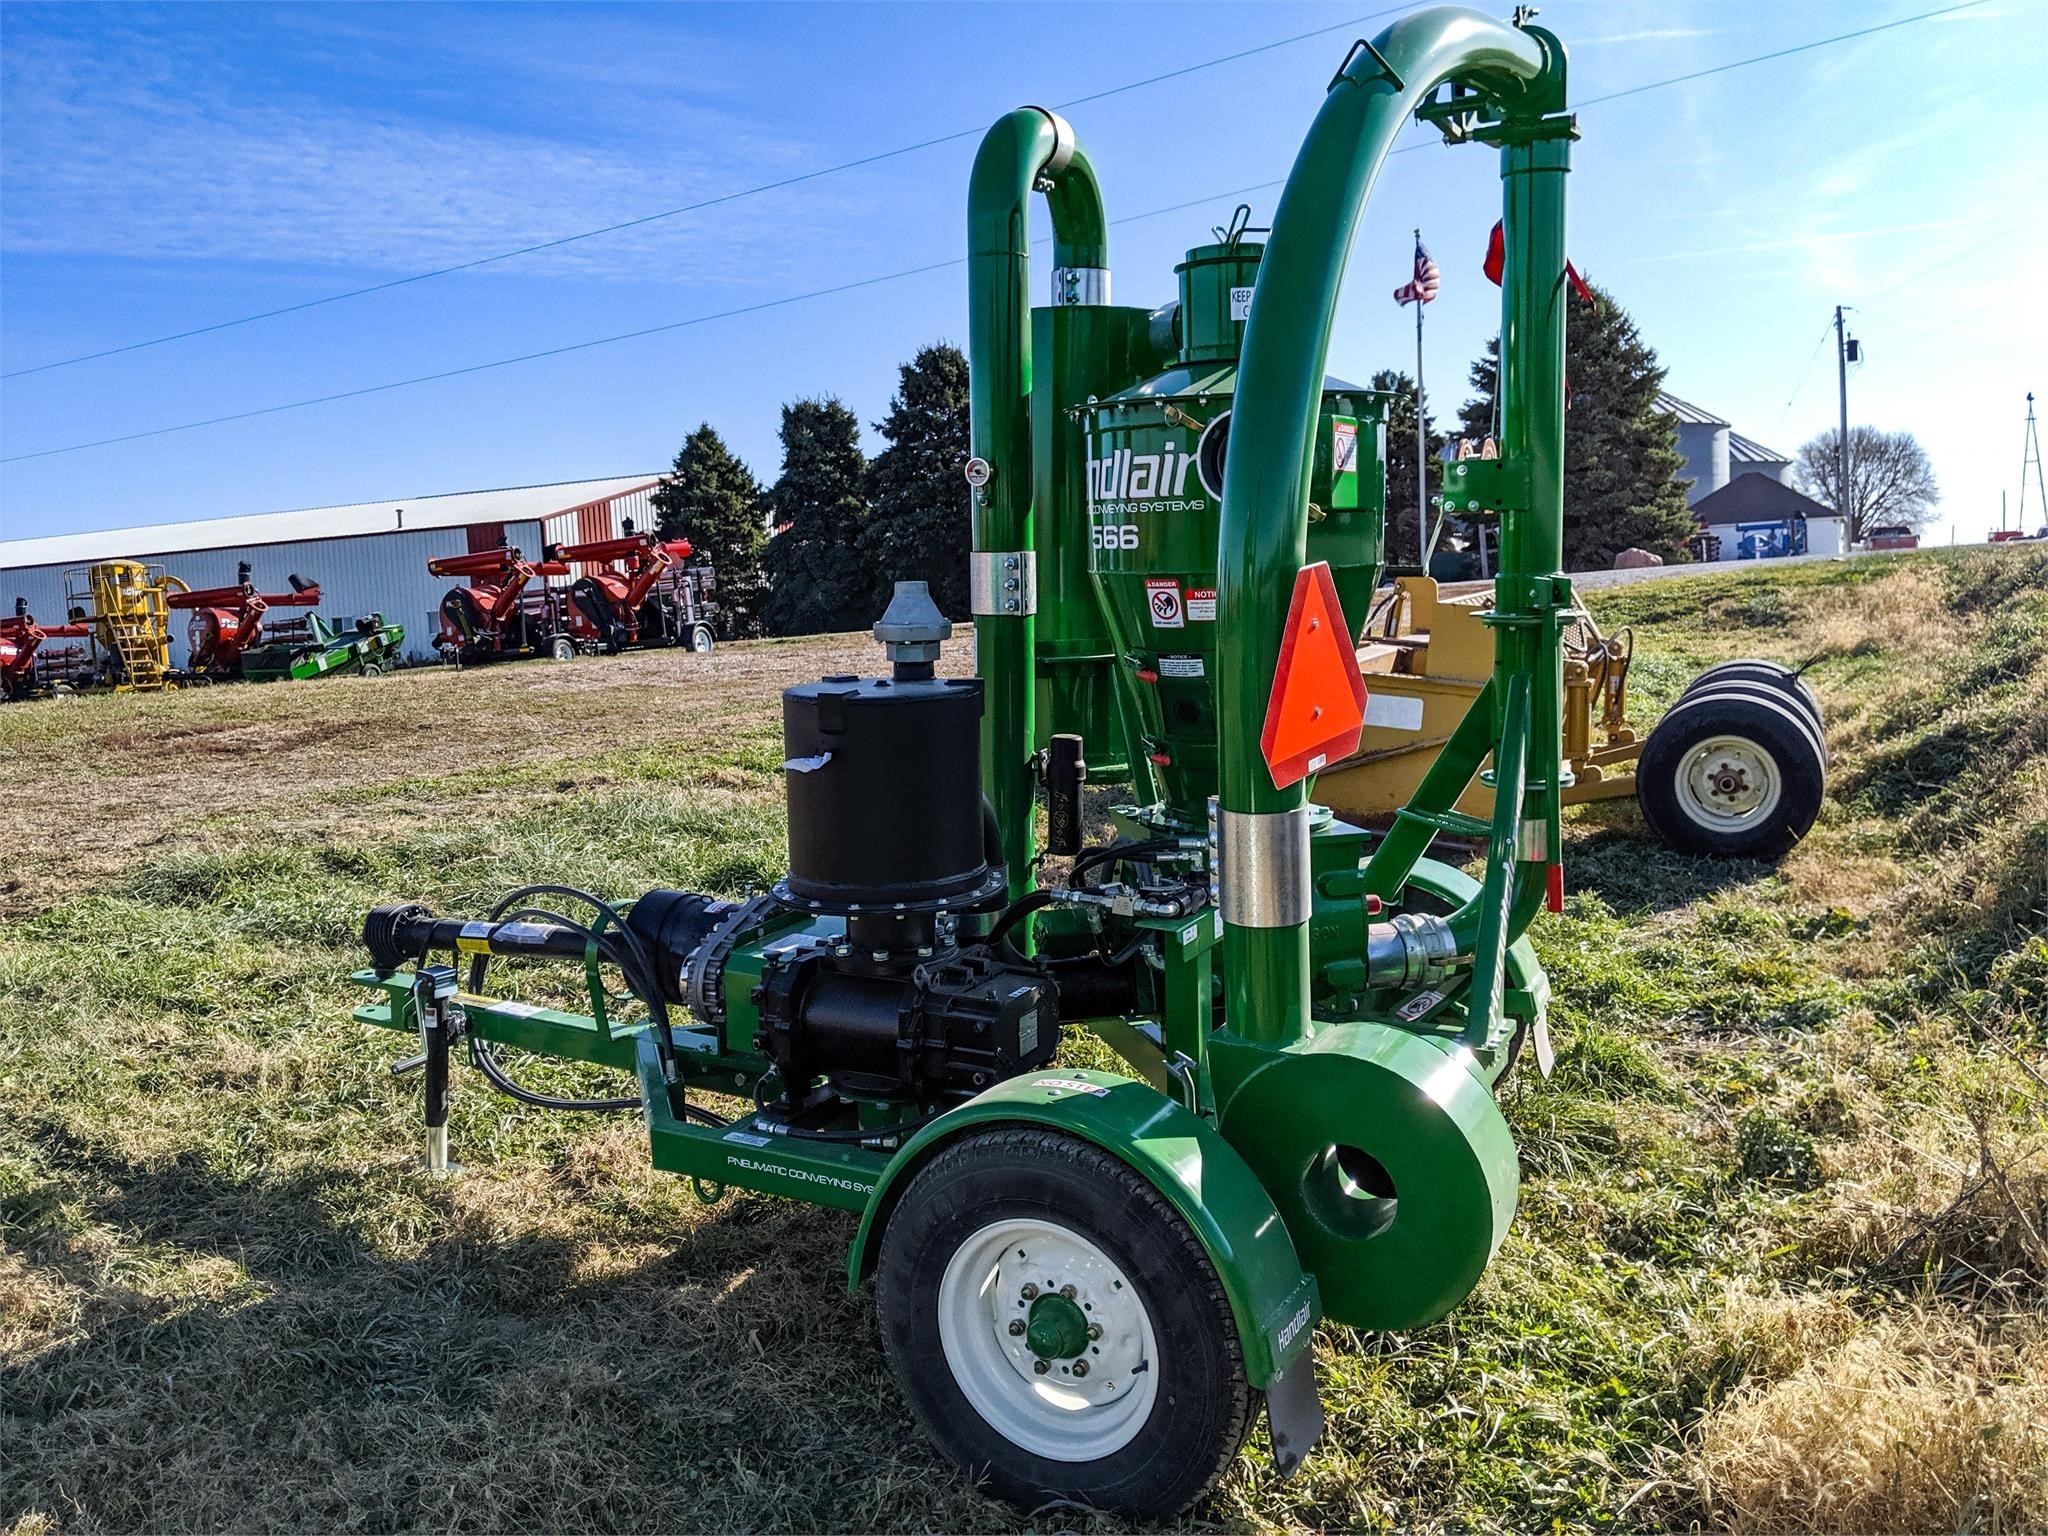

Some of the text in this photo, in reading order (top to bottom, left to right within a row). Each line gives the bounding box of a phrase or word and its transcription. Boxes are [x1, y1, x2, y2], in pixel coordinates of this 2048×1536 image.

[1231, 290, 1251, 303] KEEP
[1140, 500, 1205, 513] SYSTEMS
[1067, 1081, 1106, 1095] STEP
[727, 1156, 788, 1176] PNEUMATIC
[788, 1168, 852, 1190] CONVEYING
[1277, 1300, 1311, 1353] Handlair
